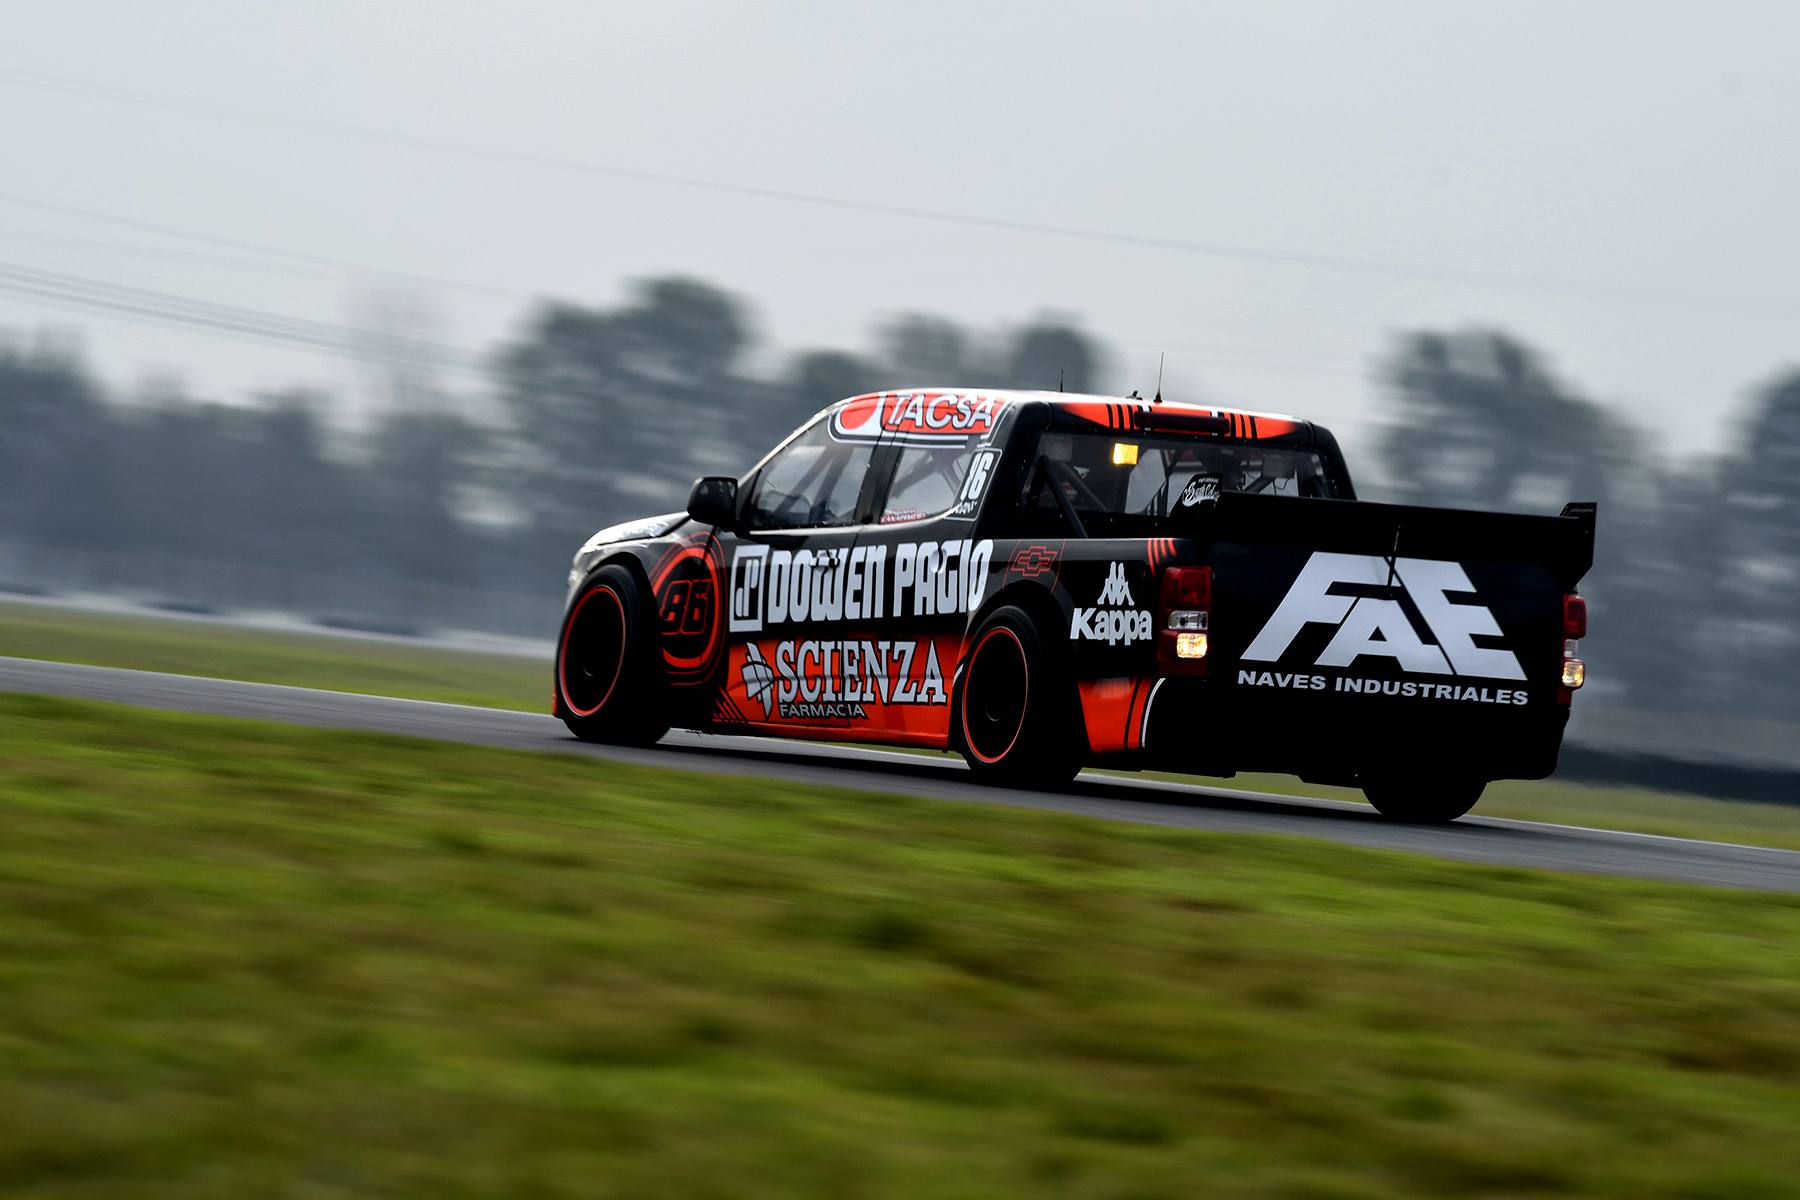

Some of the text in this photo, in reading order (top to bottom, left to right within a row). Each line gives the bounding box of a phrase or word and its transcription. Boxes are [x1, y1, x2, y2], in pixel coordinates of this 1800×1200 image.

[889, 393, 995, 428] TACSA
[768, 539, 993, 623] DOWEN PAGIO
[658, 579, 711, 634] 86
[1070, 608, 1152, 645] Kappa
[1240, 552, 1528, 680] FAE
[776, 640, 947, 704] SCIENZA
[1238, 670, 1528, 706] NAVES INDUSTRIALES
[780, 704, 866, 717] FARMACIA
